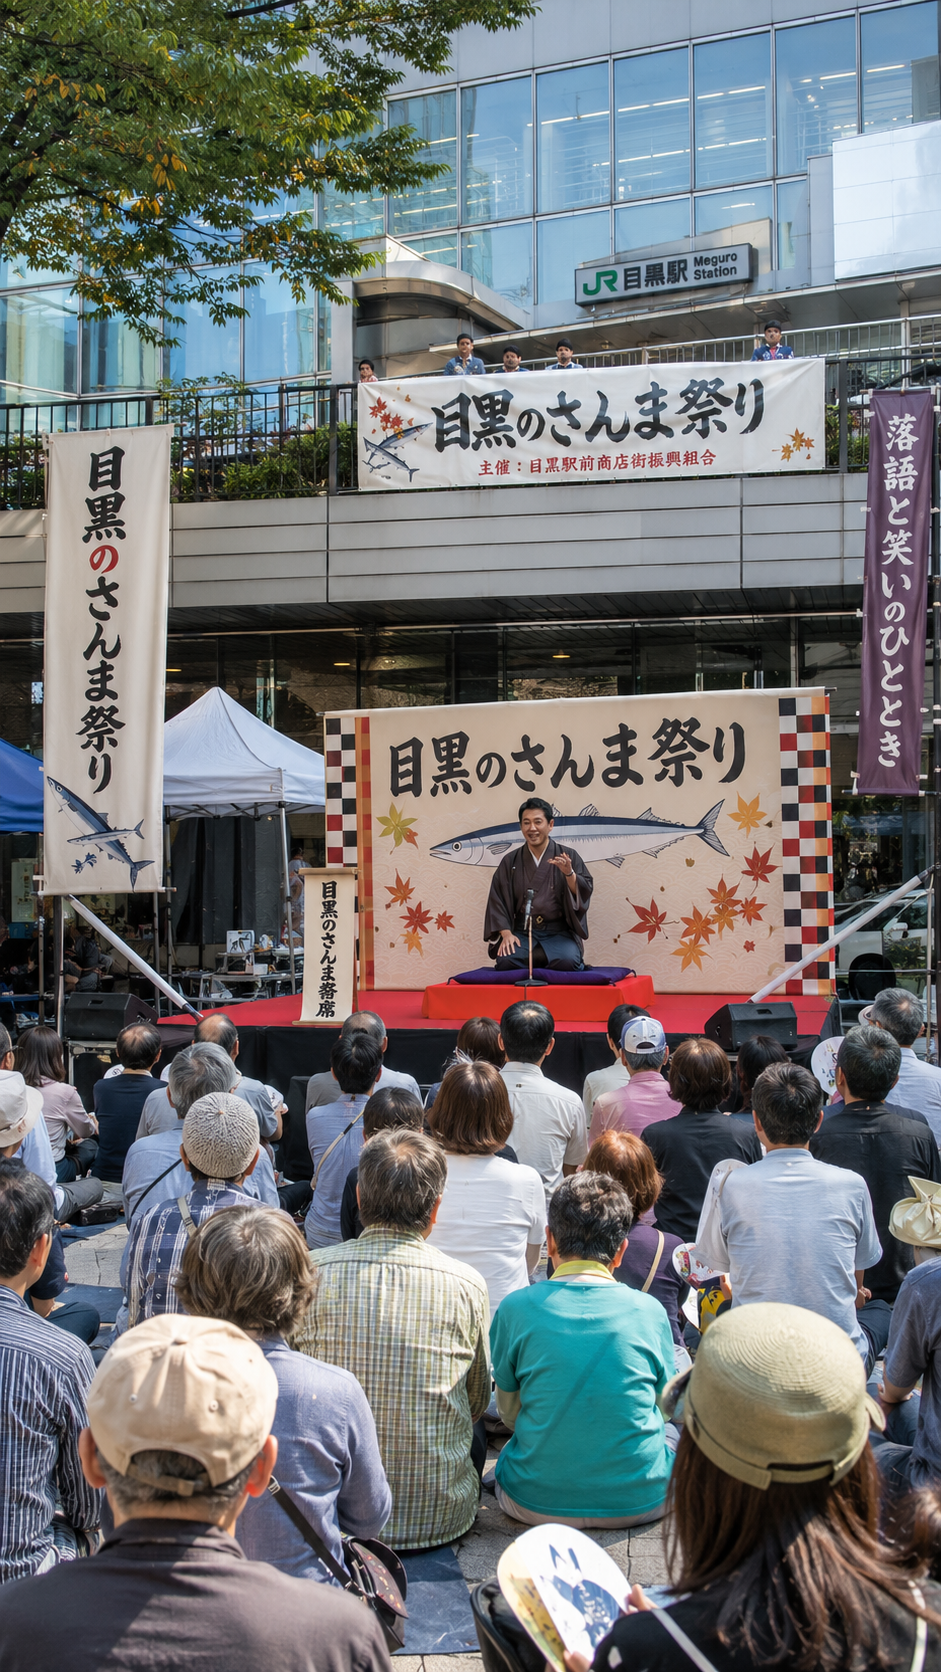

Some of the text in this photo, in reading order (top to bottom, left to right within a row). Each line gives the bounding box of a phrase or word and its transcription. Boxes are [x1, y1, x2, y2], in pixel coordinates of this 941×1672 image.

[583, 258, 688, 296] JR 目黒駅
[693, 252, 738, 268] Meguro
[693, 266, 738, 281] Station
[431, 377, 765, 453] 目黒のさんま祭り
[75, 445, 127, 795] 目黒のさんま祭り
[878, 413, 920, 768] 落語と笑いのひととき
[389, 716, 747, 799] 目黒のさんま祭り
